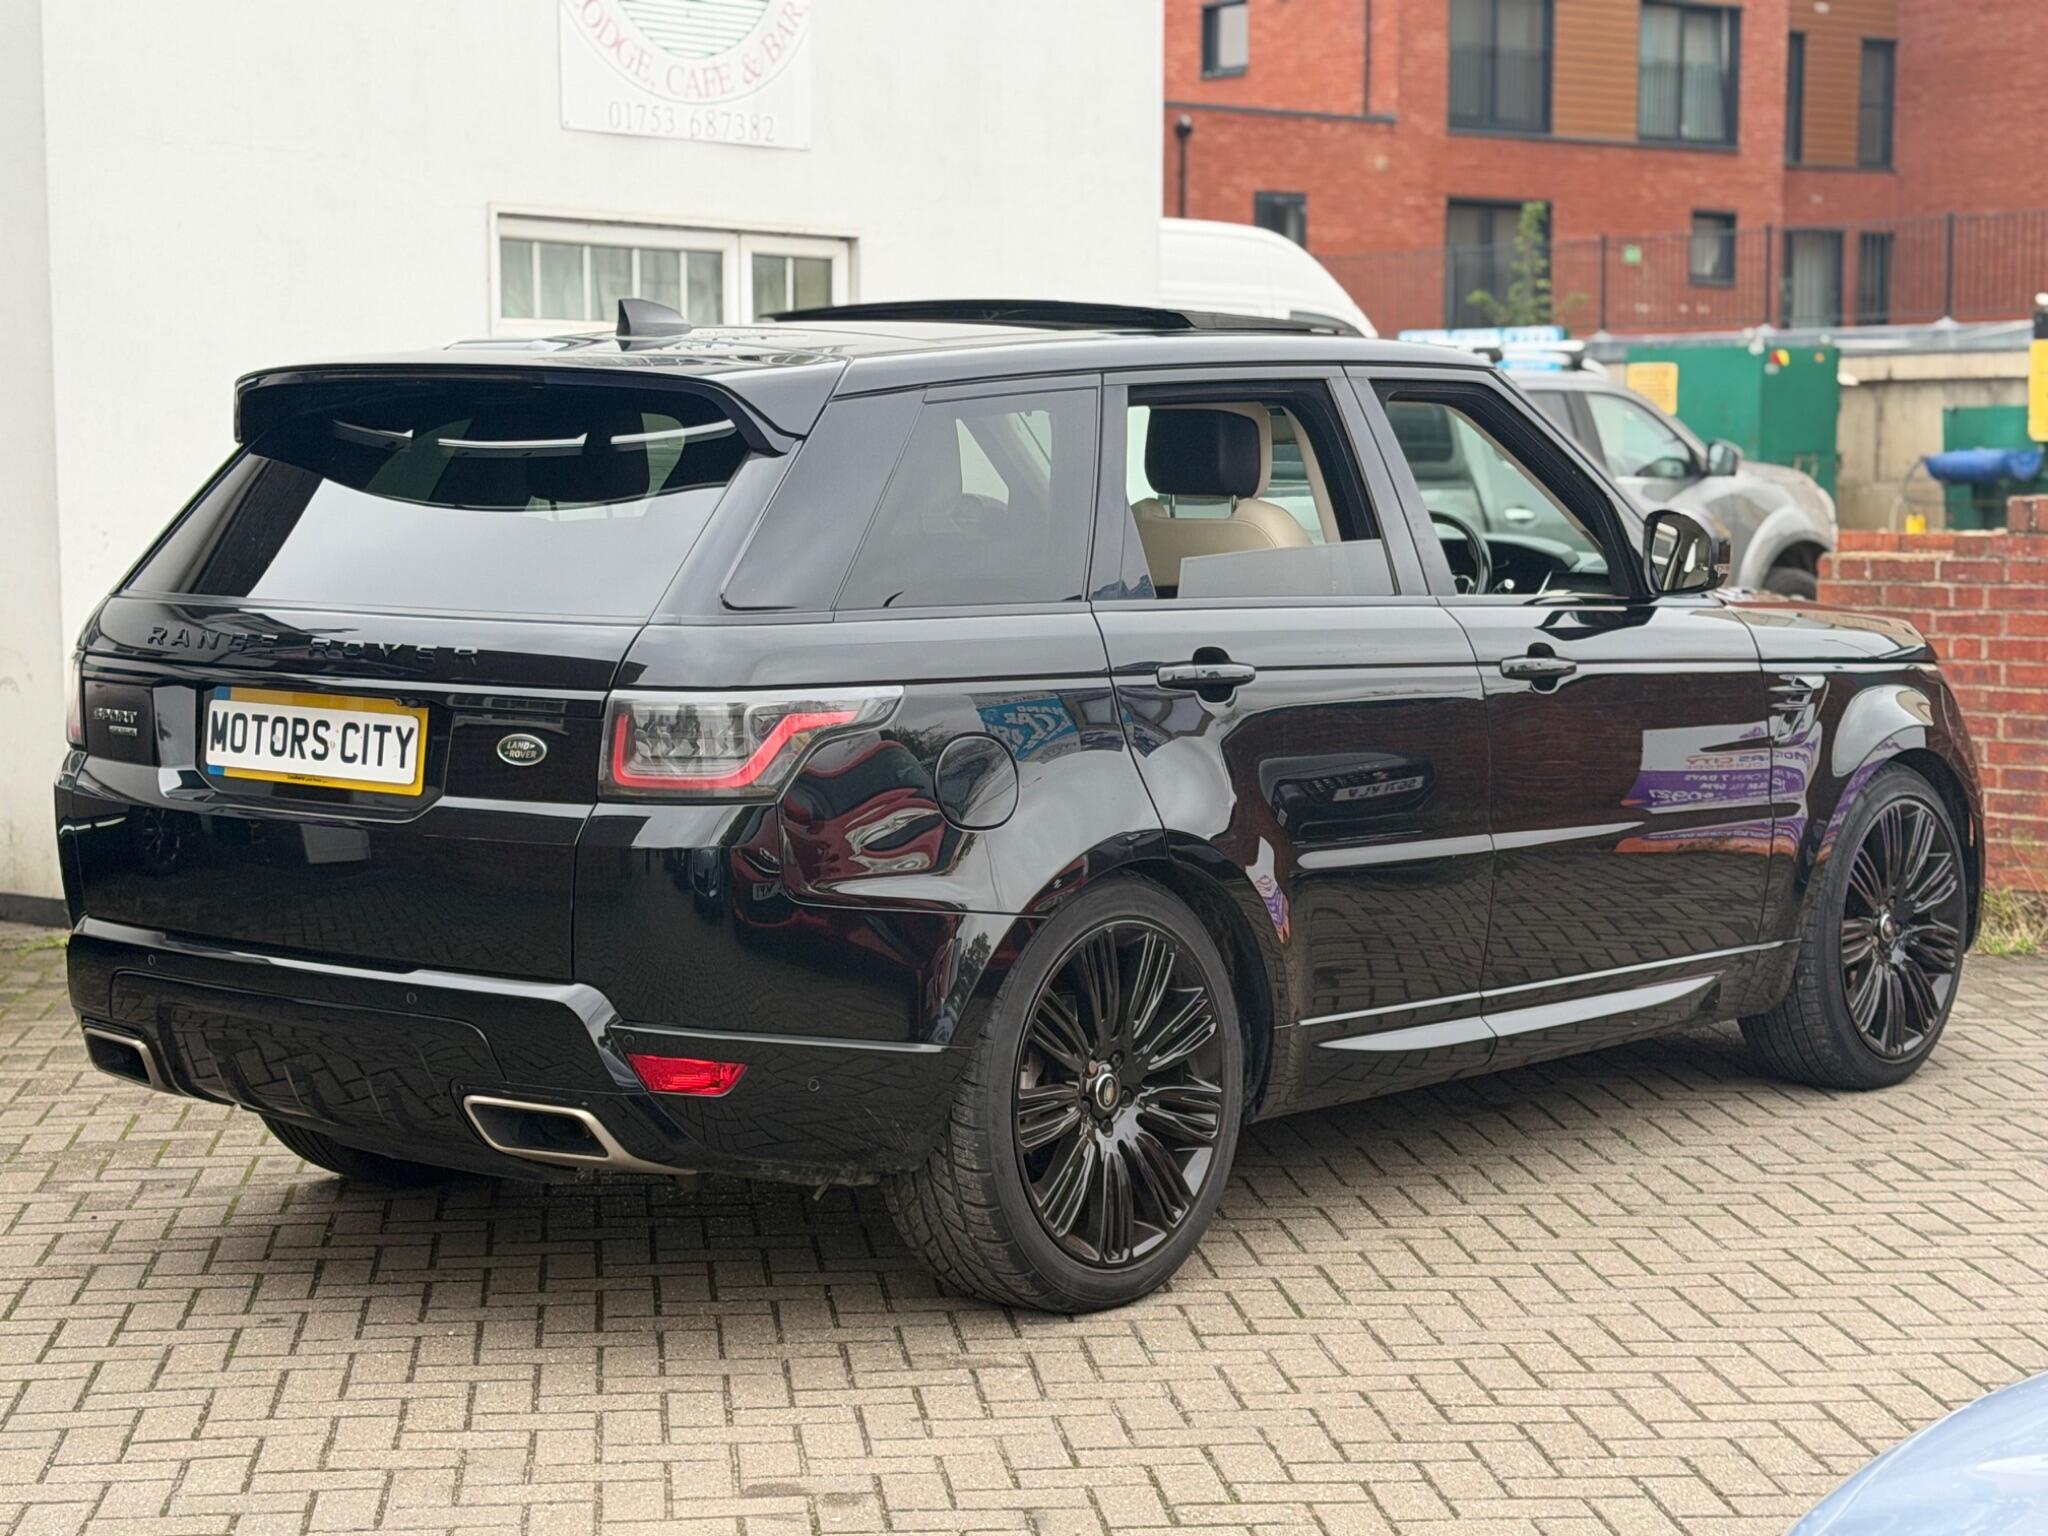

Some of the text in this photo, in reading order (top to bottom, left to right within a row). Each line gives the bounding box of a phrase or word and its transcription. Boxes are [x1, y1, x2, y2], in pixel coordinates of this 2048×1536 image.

[576, 0, 804, 98] ODGE. CAFE & BAR
[608, 101, 775, 142] 01753 687382
[146, 626, 479, 665] RANGE ROVER
[93, 707, 138, 723] SPORT
[209, 710, 416, 770] MOTORS CITY
[508, 750, 537, 759] ROVER
